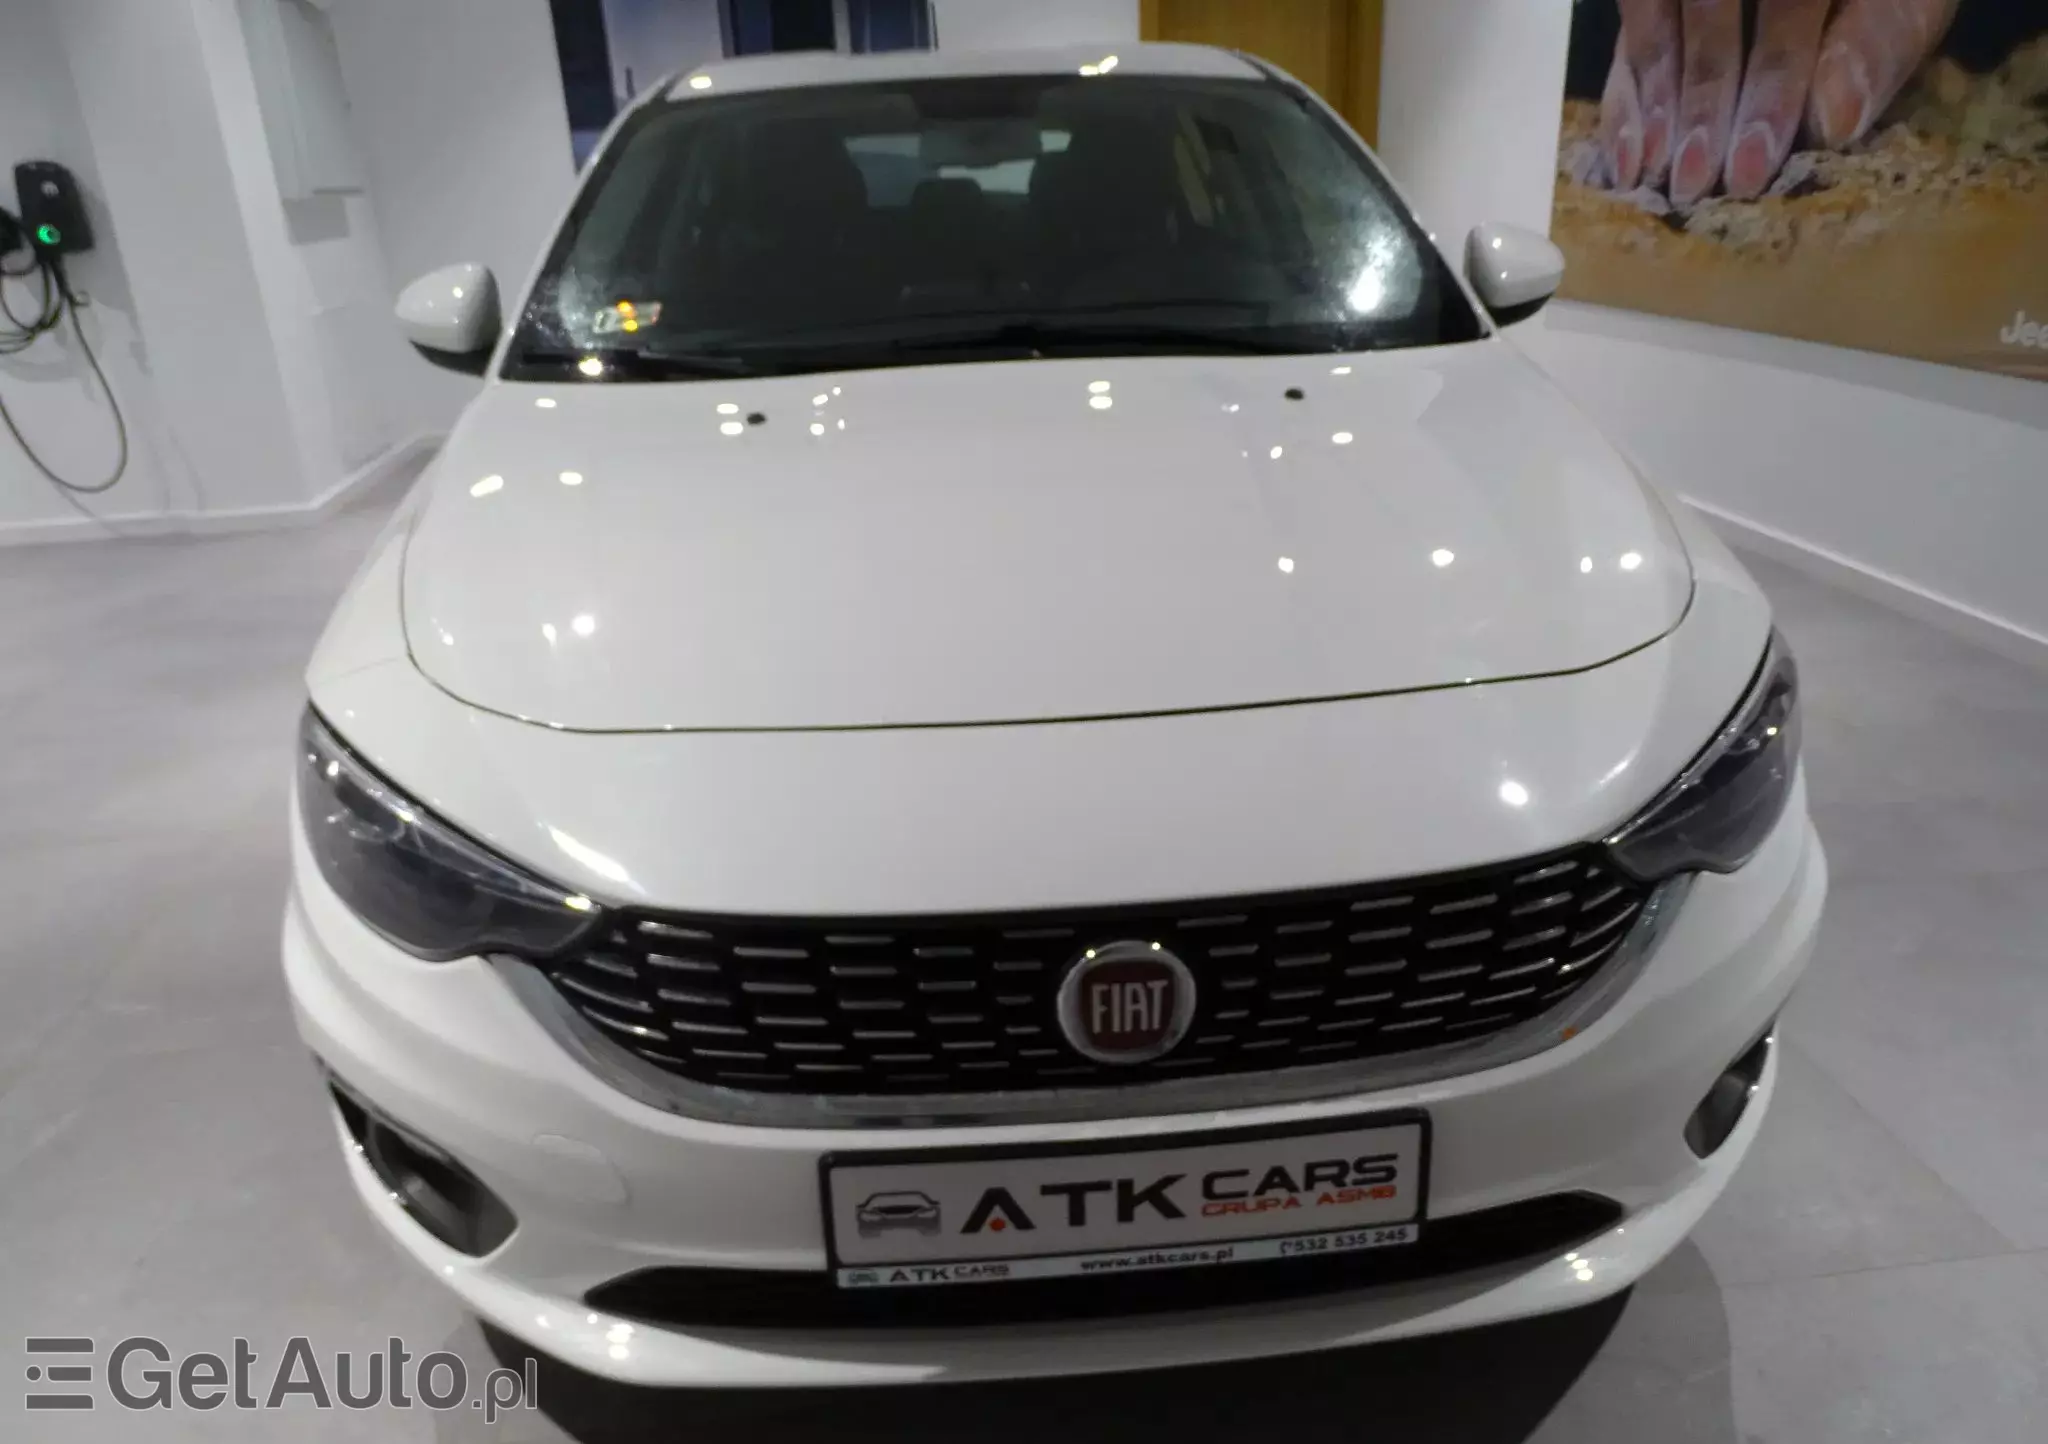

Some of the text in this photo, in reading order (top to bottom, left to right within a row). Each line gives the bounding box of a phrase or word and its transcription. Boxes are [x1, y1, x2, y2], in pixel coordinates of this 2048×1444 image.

[1091, 980, 1169, 1034] FIAT
[959, 1154, 1398, 1234] ATK CARS
[1335, 1232, 1367, 1247] 535
[1373, 1227, 1408, 1243] 245
[1080, 1247, 1234, 1271] www.atkcars.pl
[889, 1264, 1010, 1283] ATK CARS
